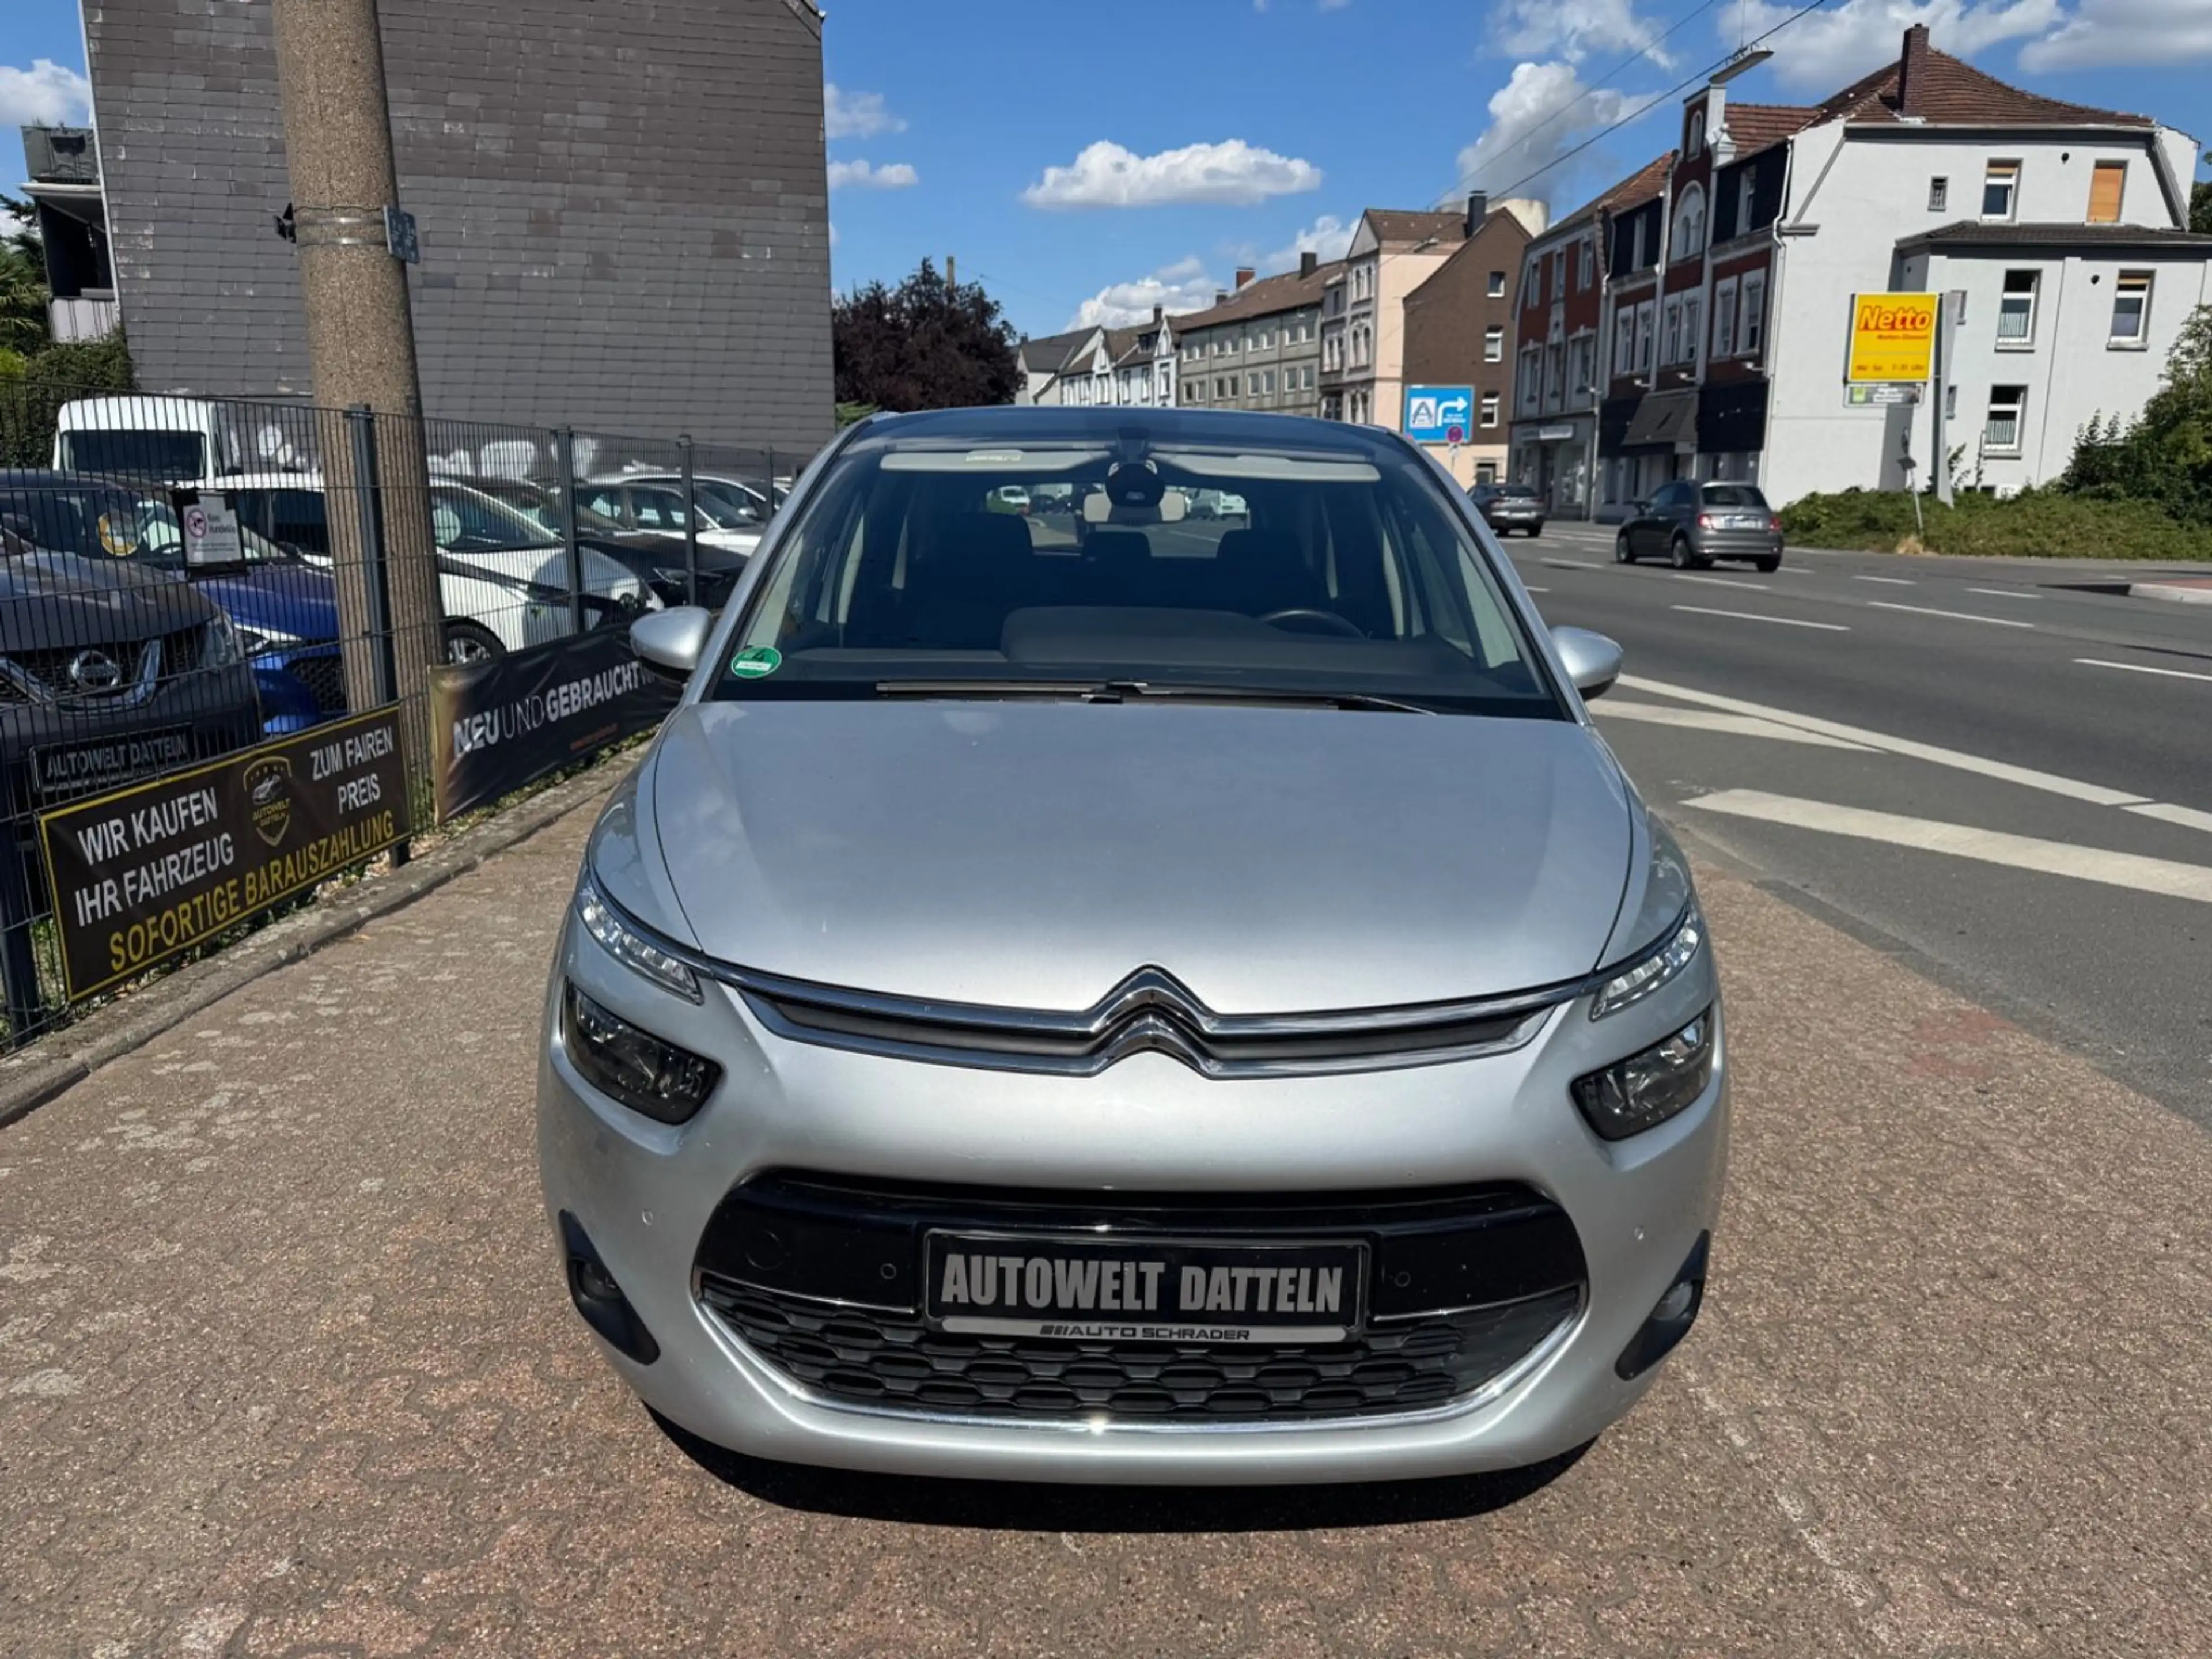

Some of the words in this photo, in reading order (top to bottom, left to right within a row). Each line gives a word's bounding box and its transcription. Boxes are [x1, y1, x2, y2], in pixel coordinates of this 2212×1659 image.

[1858, 305, 1932, 331] Netto
[47, 745, 126, 779] AUTOWELT
[310, 743, 344, 781] ZUM
[344, 725, 393, 768] FAIREN
[337, 773, 381, 814] PREIS
[77, 818, 130, 866] WIR
[131, 787, 218, 848] KAUFEN
[75, 878, 123, 927] IHR
[122, 832, 234, 907] FAHRZEUG
[109, 878, 241, 971] SOFORTIGE
[245, 810, 395, 906] BARAUSZAHLUNG
[940, 1253, 1165, 1310] AUTOWELT
[1179, 1265, 1343, 1312] DATTELN
[1069, 1325, 1137, 1338] AUTO
[1141, 1327, 1251, 1340] SCHRADER
